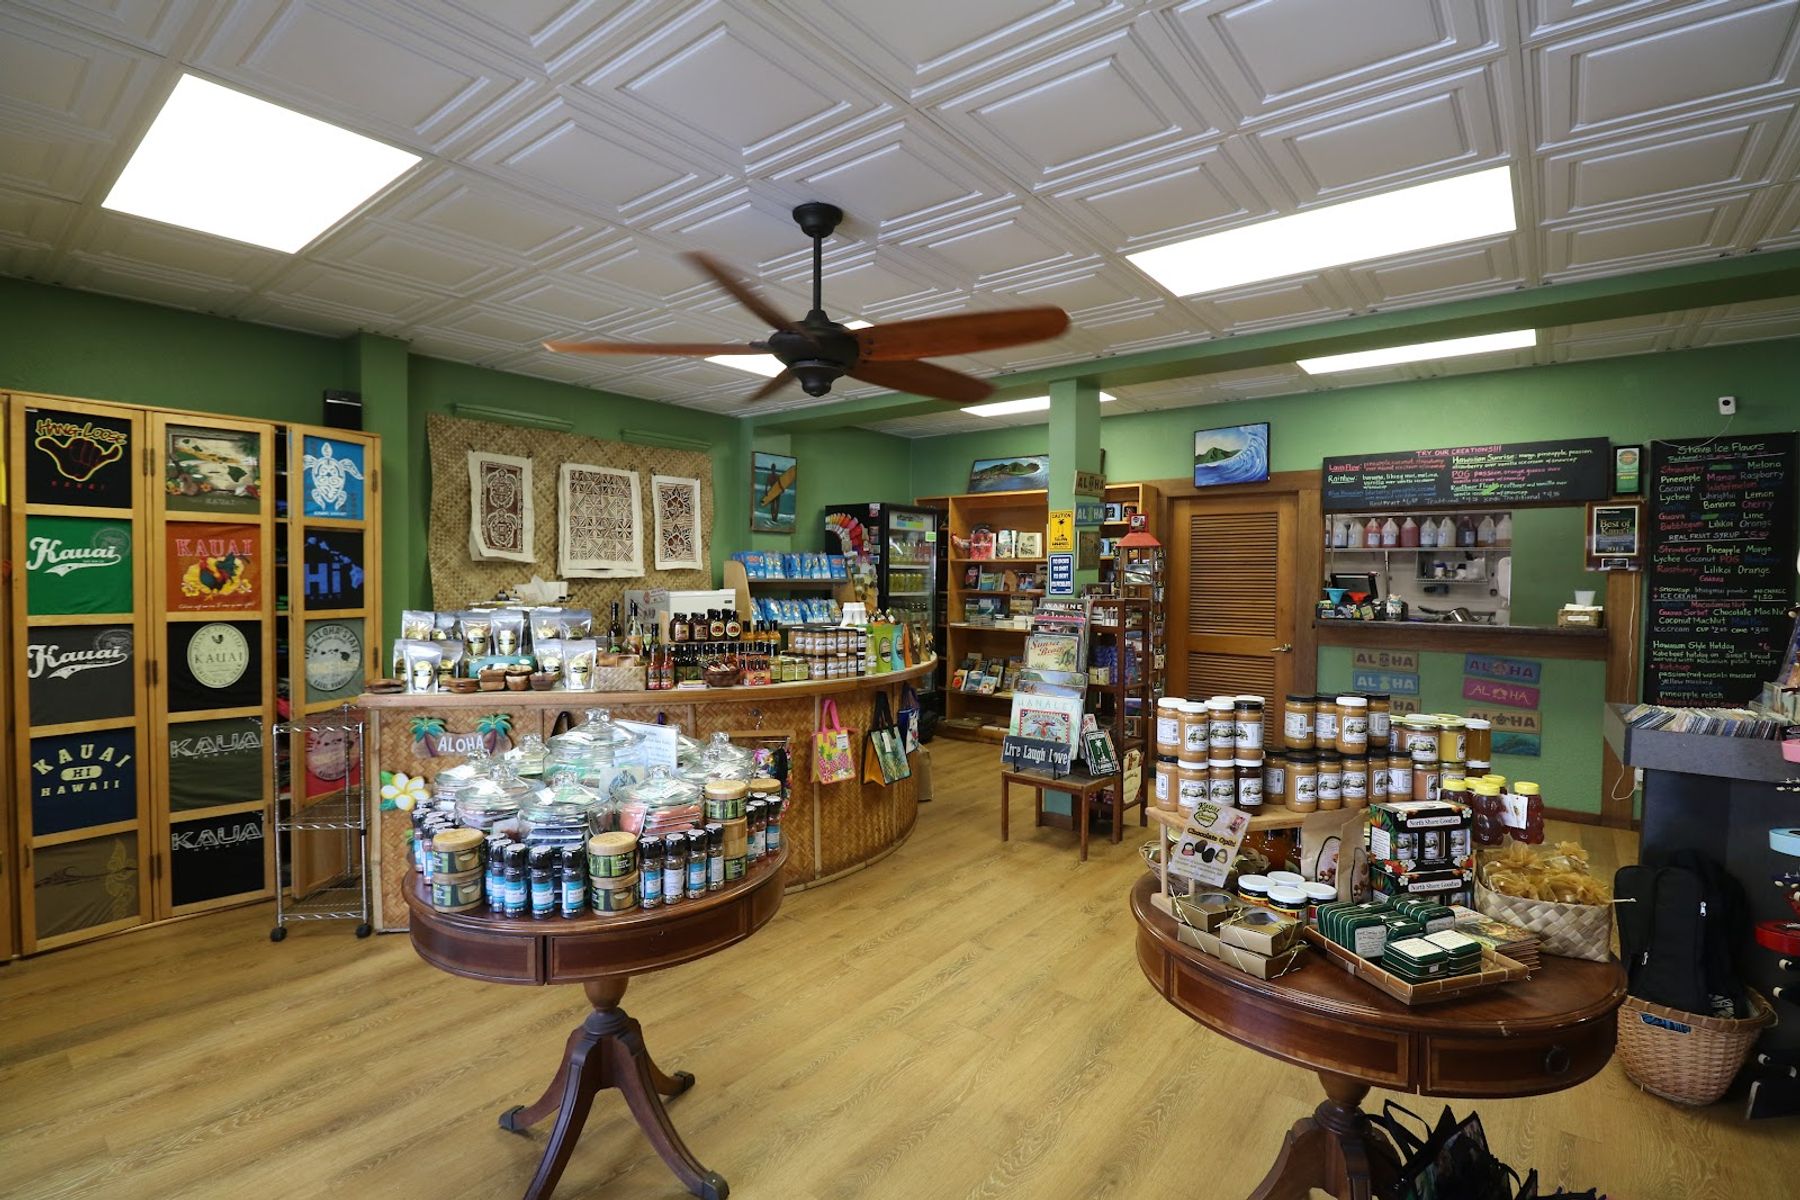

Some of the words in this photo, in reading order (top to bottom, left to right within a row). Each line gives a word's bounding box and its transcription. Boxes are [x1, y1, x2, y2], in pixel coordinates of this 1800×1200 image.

[1678, 443, 1711, 455] Shave
[1714, 443, 1729, 454] Ice
[1731, 442, 1765, 453] Flavors
[1660, 473, 1701, 484] Pineapple
[1659, 484, 1695, 493] Coconut
[1660, 493, 1691, 505] Lychee
[1744, 490, 1775, 500] Lemon
[1703, 500, 1736, 510] Banana
[1743, 511, 1765, 520] Lime
[1740, 519, 1772, 529] Orange
[1713, 531, 1741, 539] SYRUP
[26, 536, 118, 570] Kauai
[175, 538, 253, 557] KAUAI
[1658, 545, 1702, 554] Strawberry
[1706, 544, 1741, 556] Pineapple
[1653, 554, 1681, 563] Lychee
[1685, 554, 1716, 563] Coconut
[1737, 565, 1771, 577] Orange
[304, 562, 342, 595] Hi
[1712, 608, 1752, 616] Chocolate
[1658, 617, 1691, 625] Coconut
[1688, 641, 1707, 651] Style
[1709, 641, 1735, 653] Hotdog
[28, 644, 122, 678] Kauai
[194, 652, 243, 664] KAUAI
[170, 732, 263, 758] KAUA
[437, 734, 486, 753] ALOHA
[33, 743, 132, 776] KAUAI
[1005, 742, 1021, 758] Live
[1023, 745, 1047, 763] Laugh
[1048, 749, 1070, 765] Love
[72, 767, 92, 779] HI
[41, 779, 121, 797] HAWAII
[171, 823, 263, 850] KAUA
[1187, 827, 1217, 842] Chocolate
